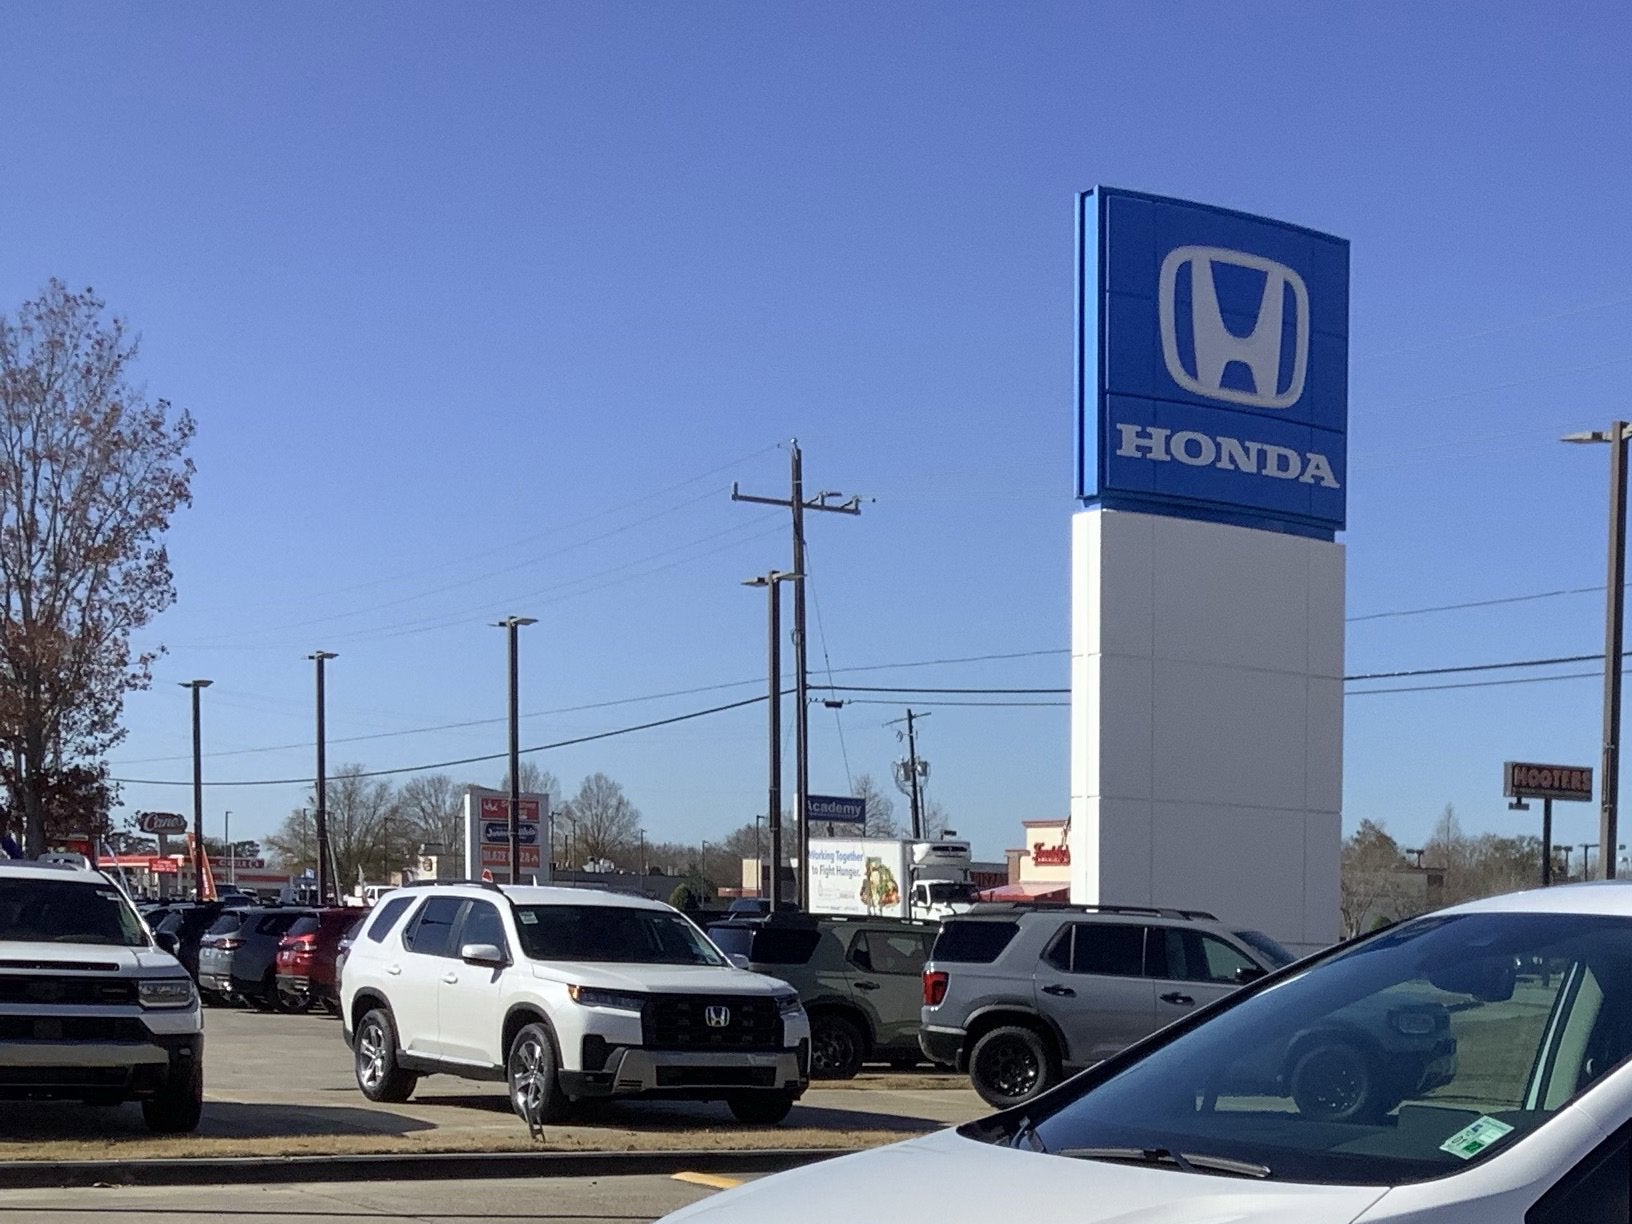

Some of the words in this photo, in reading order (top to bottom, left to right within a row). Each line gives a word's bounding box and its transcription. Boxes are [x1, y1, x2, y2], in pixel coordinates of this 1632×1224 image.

[1115, 423, 1341, 489] HONDA
[1514, 766, 1591, 791] HOOTERS
[835, 850, 864, 864] Together
[812, 865, 819, 875] to
[819, 865, 836, 878] Fight
[836, 866, 861, 879] Hunger.
